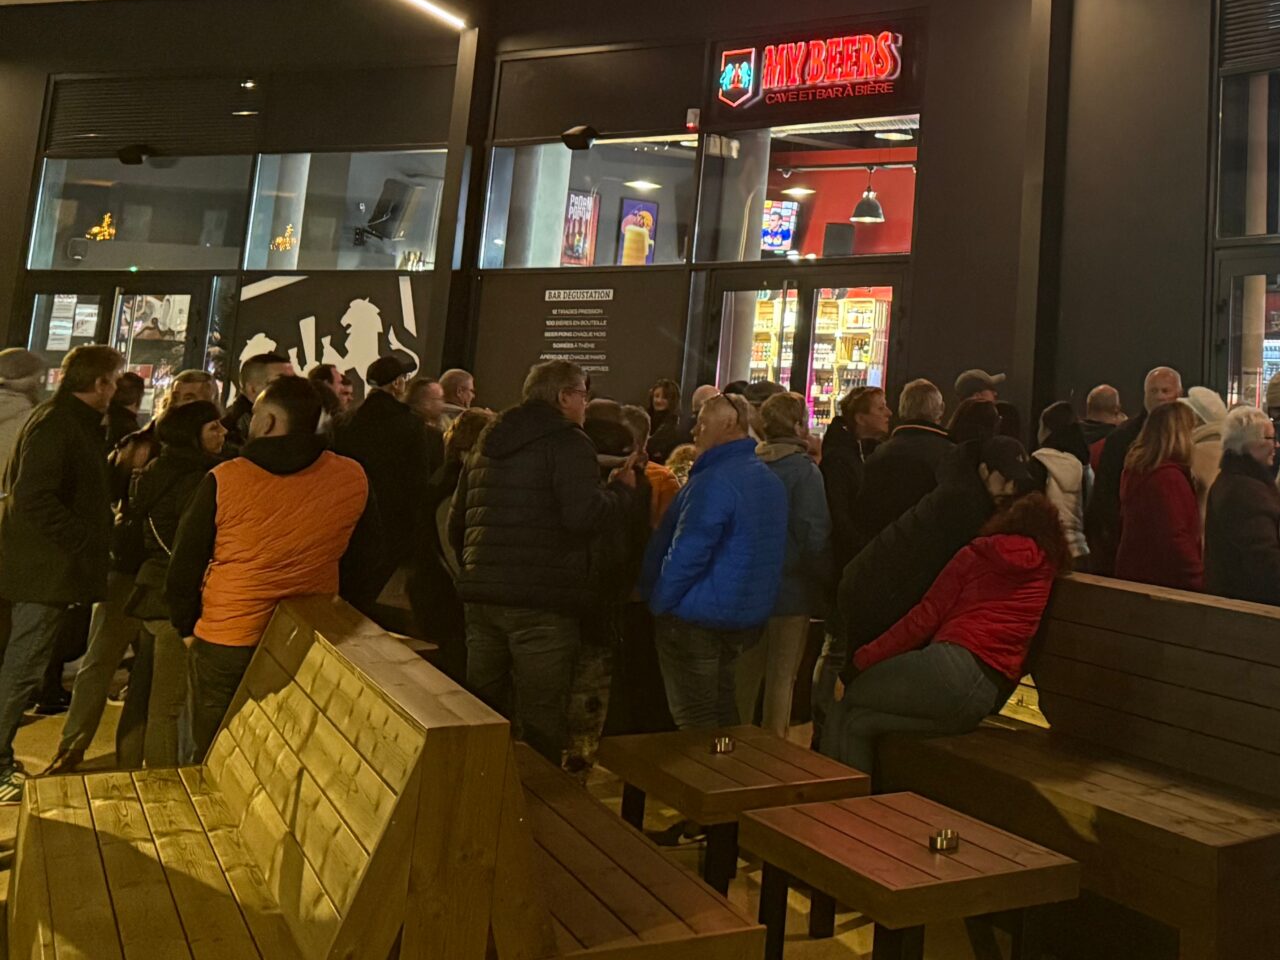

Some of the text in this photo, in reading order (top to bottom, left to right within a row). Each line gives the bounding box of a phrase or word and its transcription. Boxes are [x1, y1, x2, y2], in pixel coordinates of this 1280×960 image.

[762, 31, 893, 89] MY BEERS
[765, 92, 798, 104] CAVE
[798, 90, 815, 102] ET
[816, 87, 843, 100] BAR
[855, 81, 895, 95] BIÈRE
[548, 291, 562, 300] BAR
